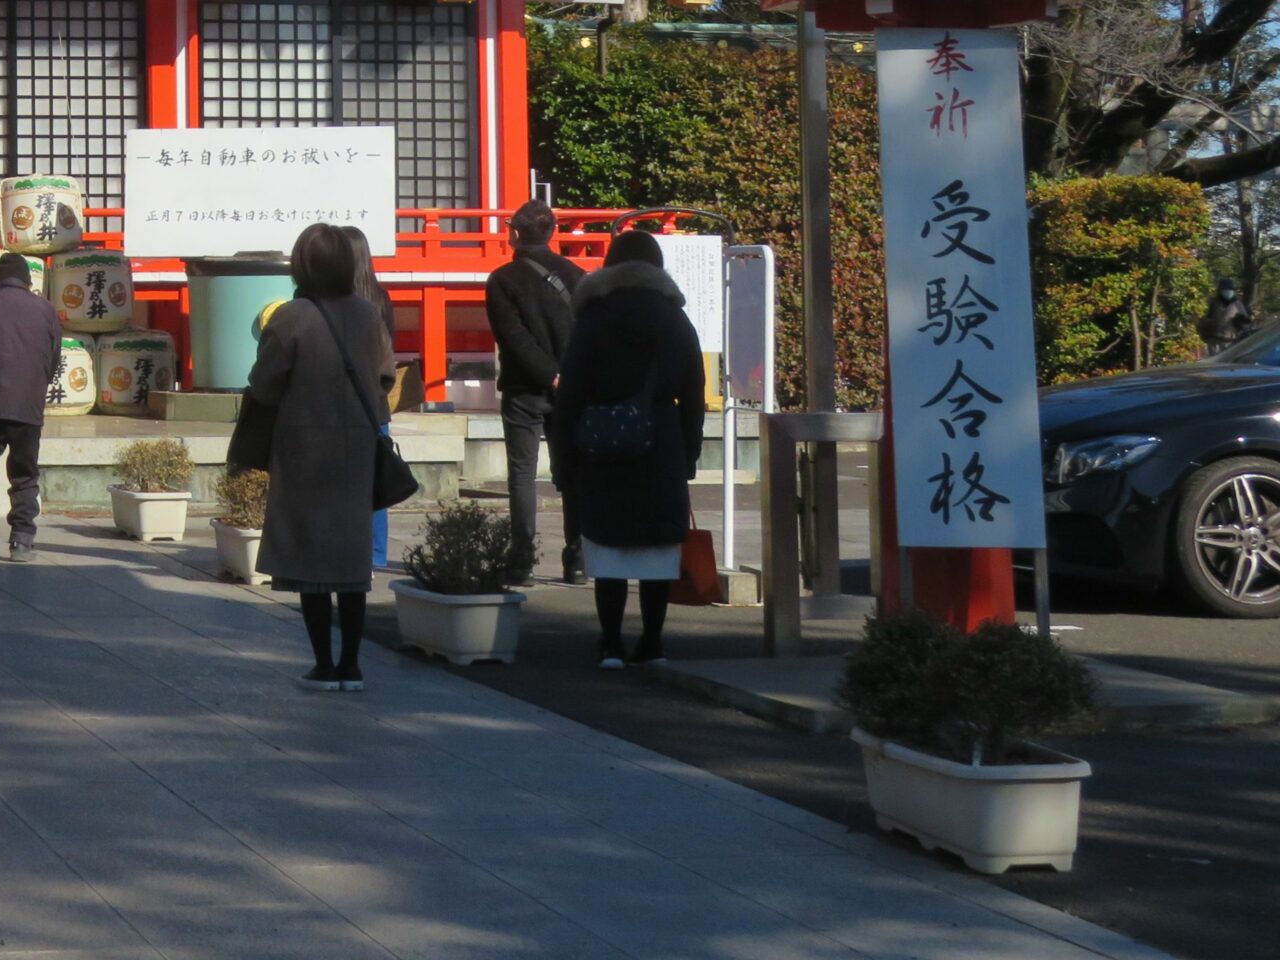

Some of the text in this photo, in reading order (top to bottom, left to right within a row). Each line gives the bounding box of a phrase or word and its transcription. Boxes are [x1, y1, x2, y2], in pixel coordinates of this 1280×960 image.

[925, 31, 975, 141] 奉祈
[916, 179, 1011, 526] 受験合格
